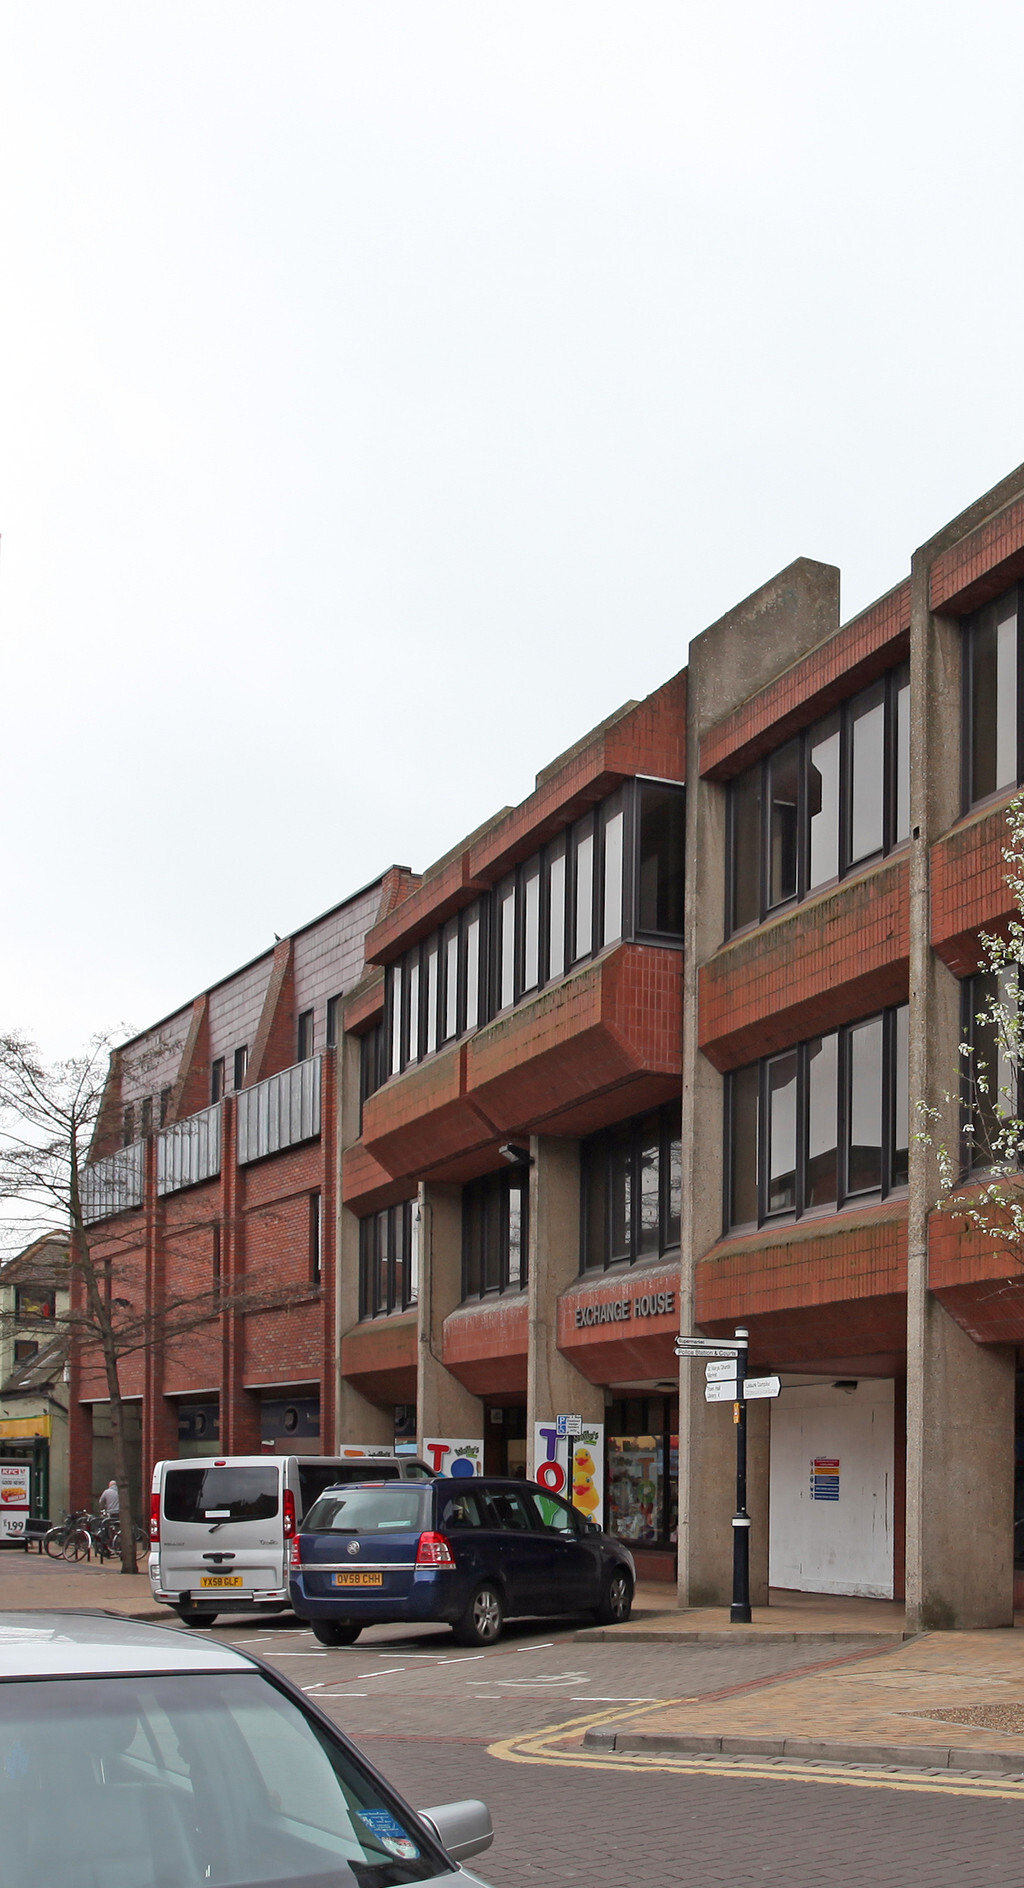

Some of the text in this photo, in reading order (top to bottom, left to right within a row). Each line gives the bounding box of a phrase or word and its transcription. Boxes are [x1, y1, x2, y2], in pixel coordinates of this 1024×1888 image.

[575, 1291, 674, 1328] EXCHANGE HOUSE
[202, 1577, 239, 1586] YX58 GLF
[362, 1574, 381, 1584] CHH
